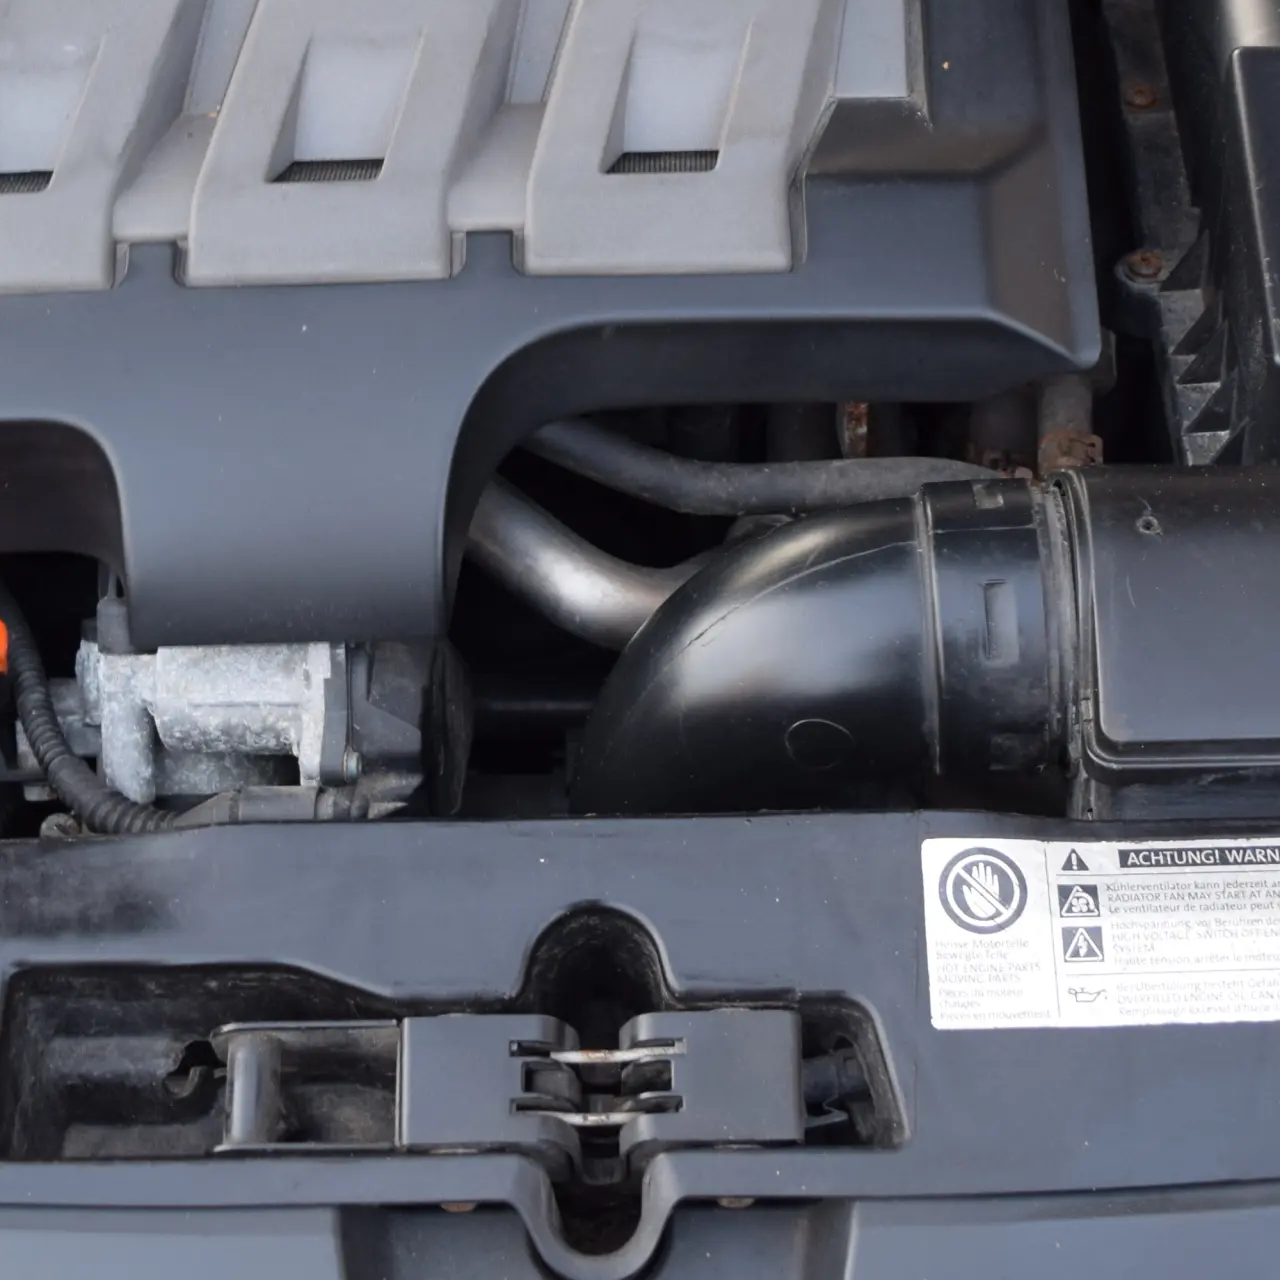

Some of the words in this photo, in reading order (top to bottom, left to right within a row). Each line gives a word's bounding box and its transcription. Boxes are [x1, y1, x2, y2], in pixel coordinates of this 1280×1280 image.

[1127, 849, 1220, 866] ACHTUNG!
[1193, 880, 1220, 890] kann
[1222, 879, 1268, 892] jederzeit
[1107, 892, 1161, 903] RADIATOR
[1163, 891, 1185, 902] FAN
[1187, 891, 1212, 901] MAY
[1215, 889, 1246, 900] START
[1249, 889, 1263, 899] AT
[1122, 902, 1181, 913] ventilateur
[1183, 901, 1196, 912] de
[1198, 901, 1247, 912] radiateur
[1249, 900, 1274, 913] peut
